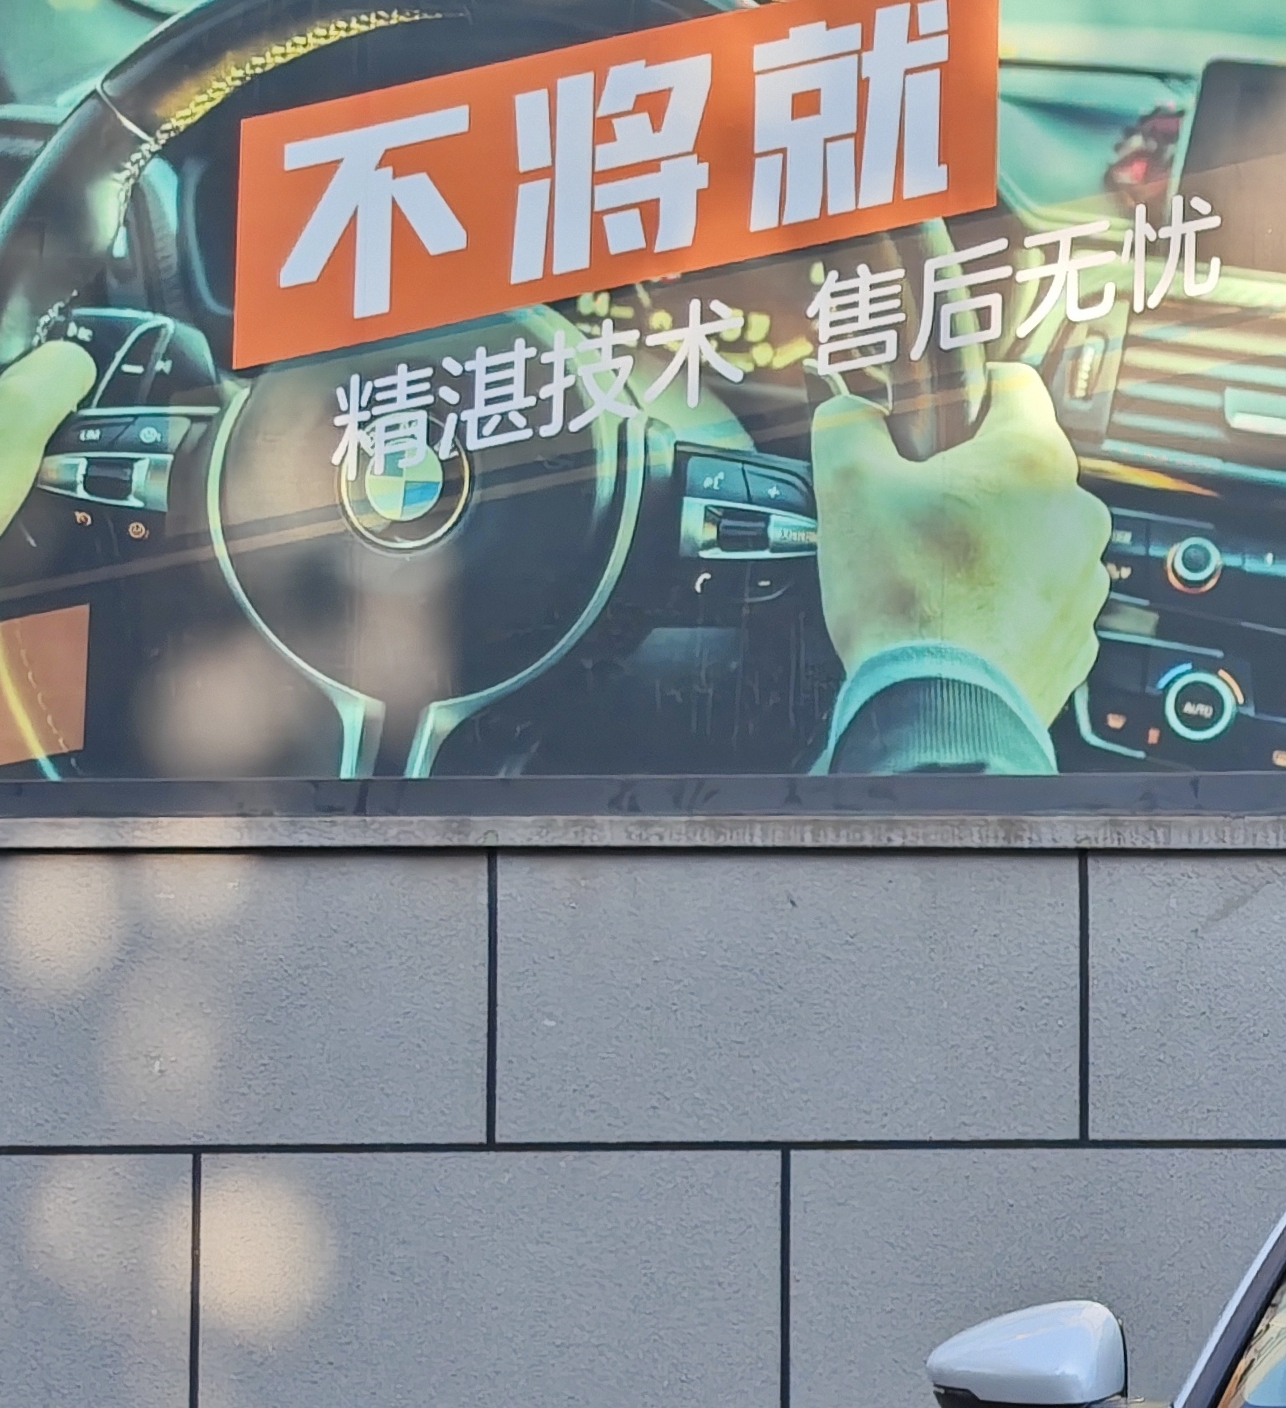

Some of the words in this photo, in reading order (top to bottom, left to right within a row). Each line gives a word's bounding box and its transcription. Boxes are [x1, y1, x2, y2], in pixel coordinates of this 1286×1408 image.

[279, 0, 950, 320] 不将就
[806, 196, 1221, 377] 售后无忧
[331, 298, 744, 481] 精湛技术
